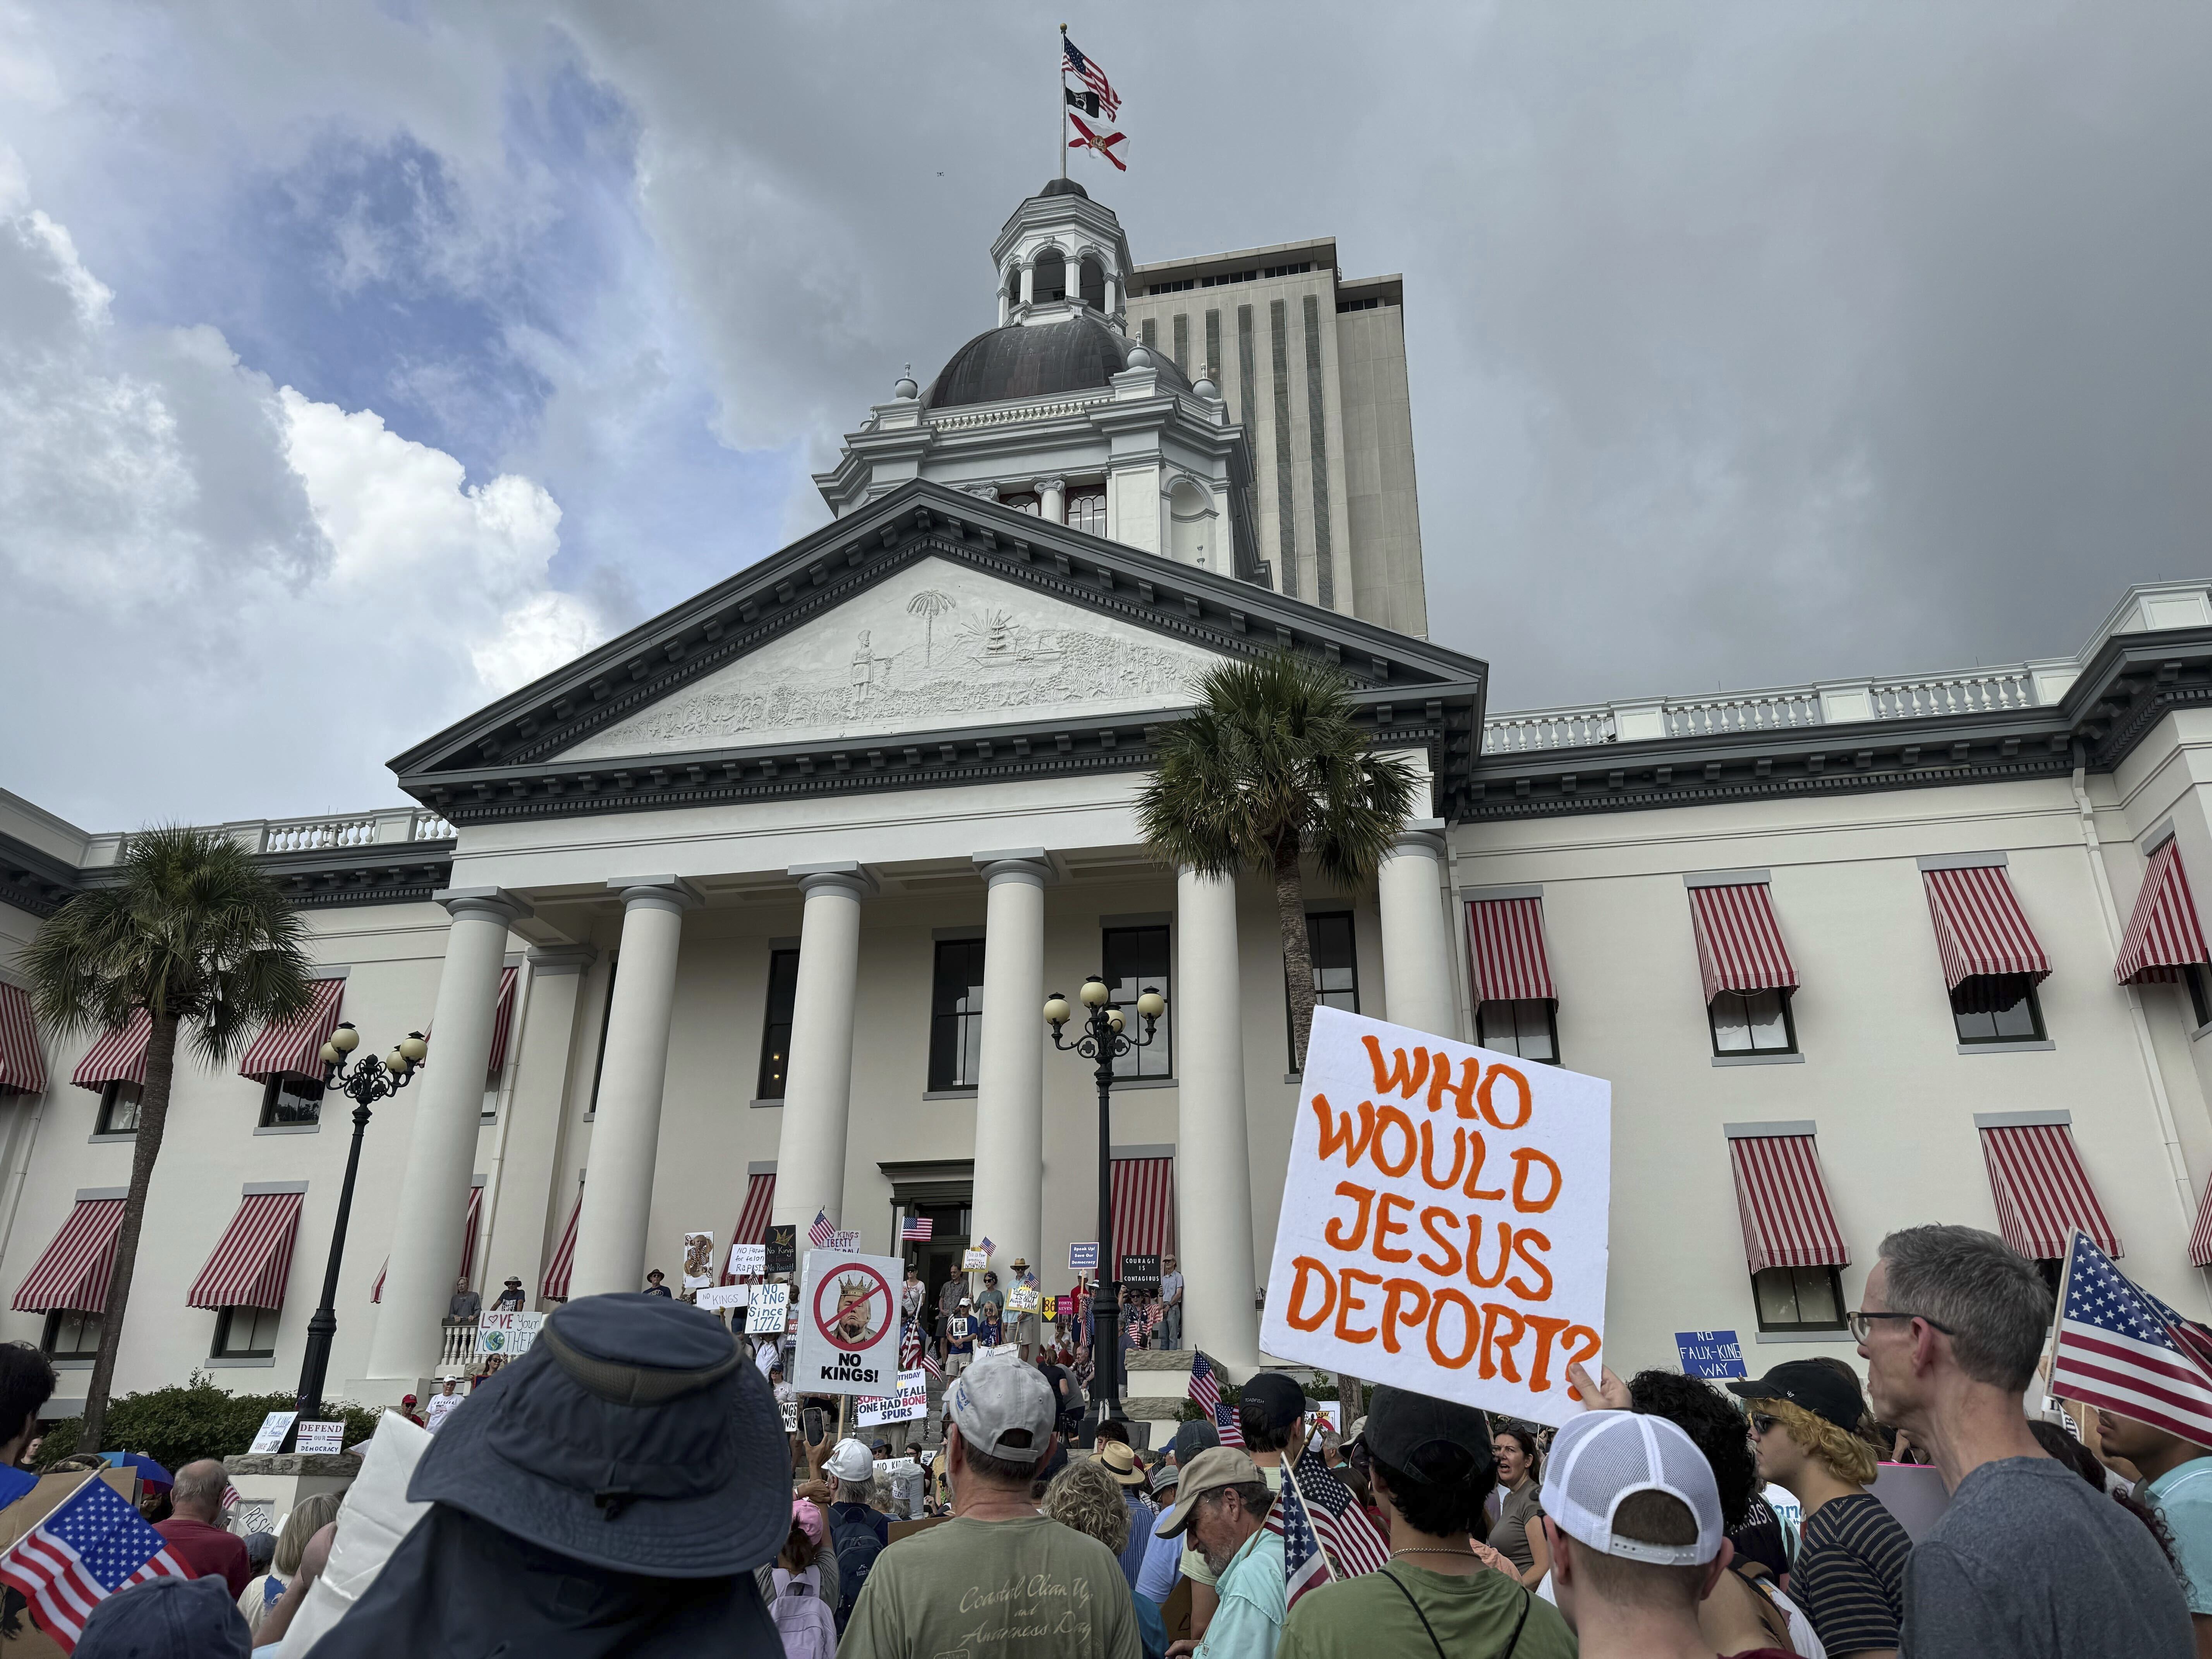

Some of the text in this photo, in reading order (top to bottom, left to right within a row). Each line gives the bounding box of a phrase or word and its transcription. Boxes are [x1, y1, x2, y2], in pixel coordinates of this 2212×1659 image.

[1362, 1035, 1532, 1130] WHO
[1311, 1093, 1562, 1213] WOULD
[823, 1238, 853, 1247] LIBERTY
[1325, 1180, 1553, 1302] JESUS
[767, 1247, 775, 1255] No
[762, 1284, 778, 1295] NO
[713, 1294, 738, 1305] KINGS
[1045, 1299, 1055, 1312] 86
[749, 1307, 783, 1317] Since
[753, 1317, 781, 1331] 1776
[1286, 1255, 1602, 1402] DEPORT?
[1697, 1331, 1714, 1341] NO
[1680, 1343, 1742, 1360] FAUX-KING
[838, 1353, 861, 1367] NO
[821, 1366, 879, 1383] KINGS!
[1699, 1363, 1728, 1377] WAY
[910, 1385, 926, 1396] ALL
[780, 1403, 797, 1417] INGS
[859, 1395, 926, 1413] ONE HAD BONE
[263, 1415, 292, 1426] NO KING
[881, 1407, 912, 1420] SPURS
[300, 1424, 342, 1432] DEFEND
[959, 1575, 1026, 1613] Coastal
[1027, 1574, 1068, 1597] Clean
[1014, 1601, 1041, 1617] and
[957, 1620, 1049, 1648] Awareness
[1053, 1611, 1091, 1647] Day
